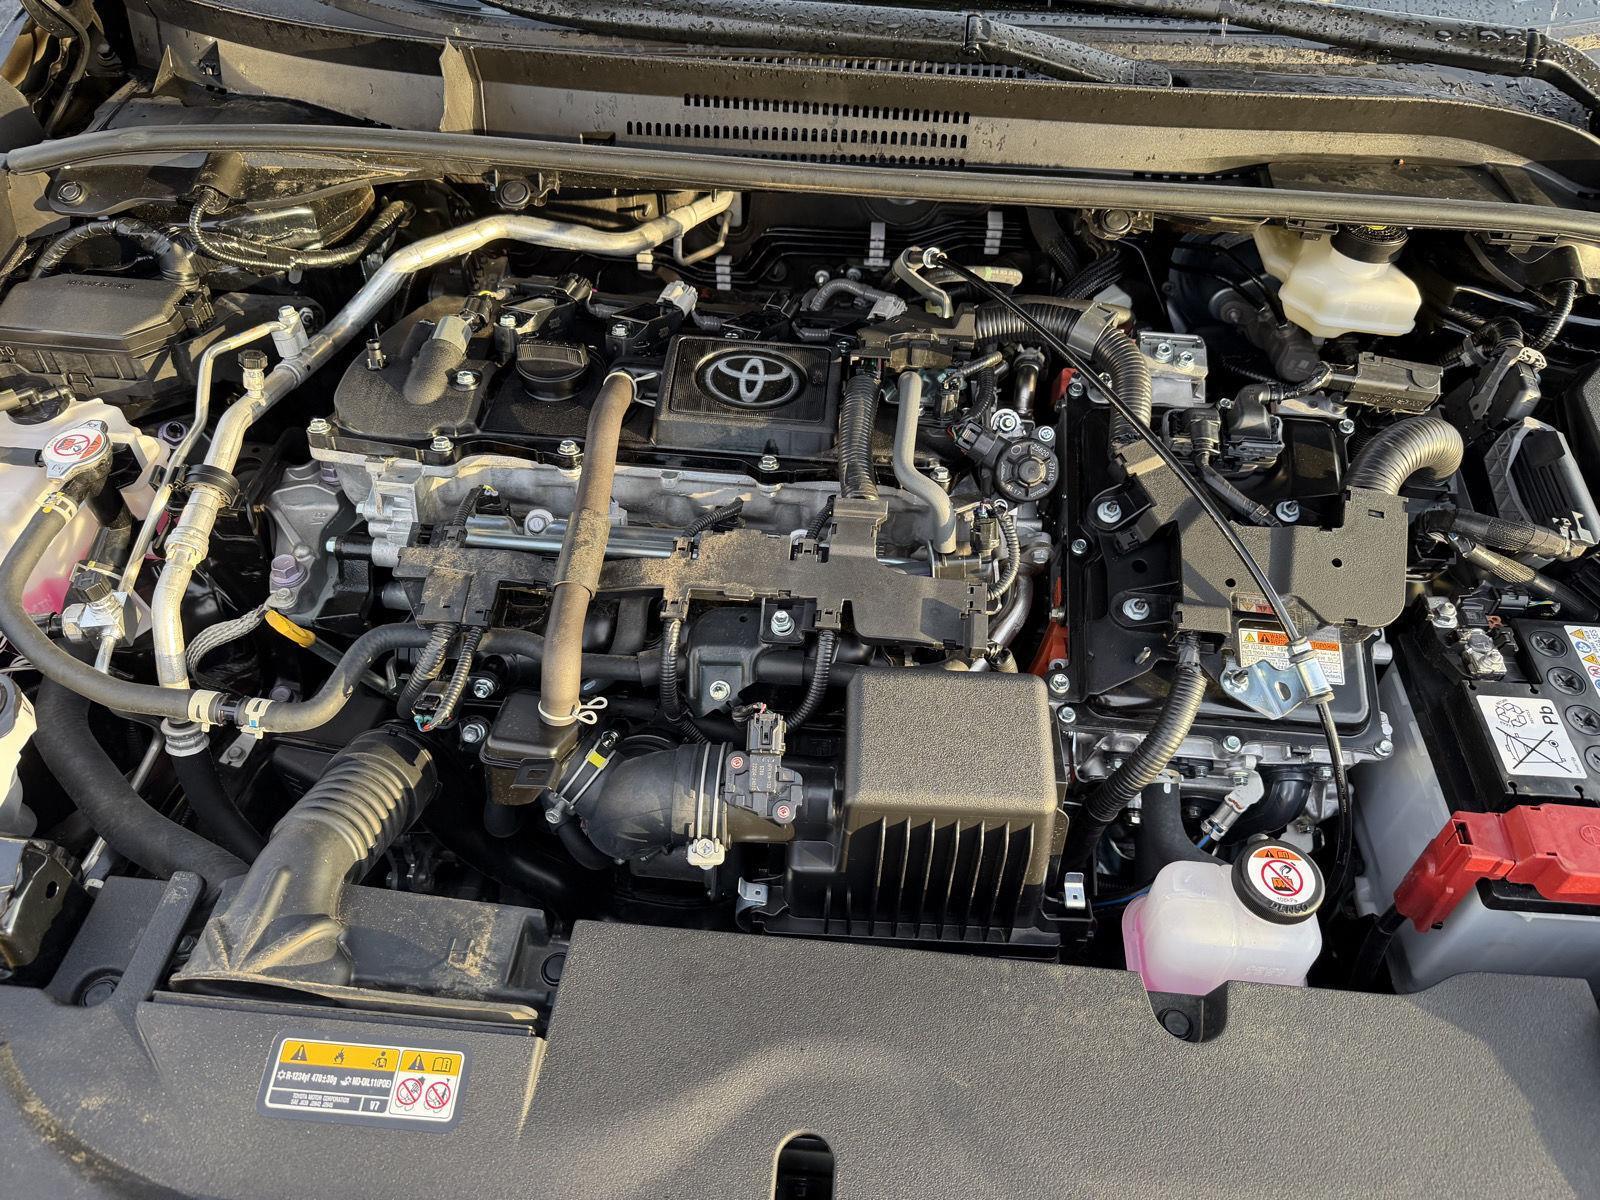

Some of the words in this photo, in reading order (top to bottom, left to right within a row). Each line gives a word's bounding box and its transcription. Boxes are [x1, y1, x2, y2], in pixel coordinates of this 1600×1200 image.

[1031, 444, 1050, 457] 25620
[1048, 463, 1056, 481] 37140
[1539, 705, 1559, 726] Pb
[1269, 902, 1308, 913] DENSO
[292, 1092, 307, 1100] TOYOTA
[323, 1095, 350, 1104] CORPORATION
